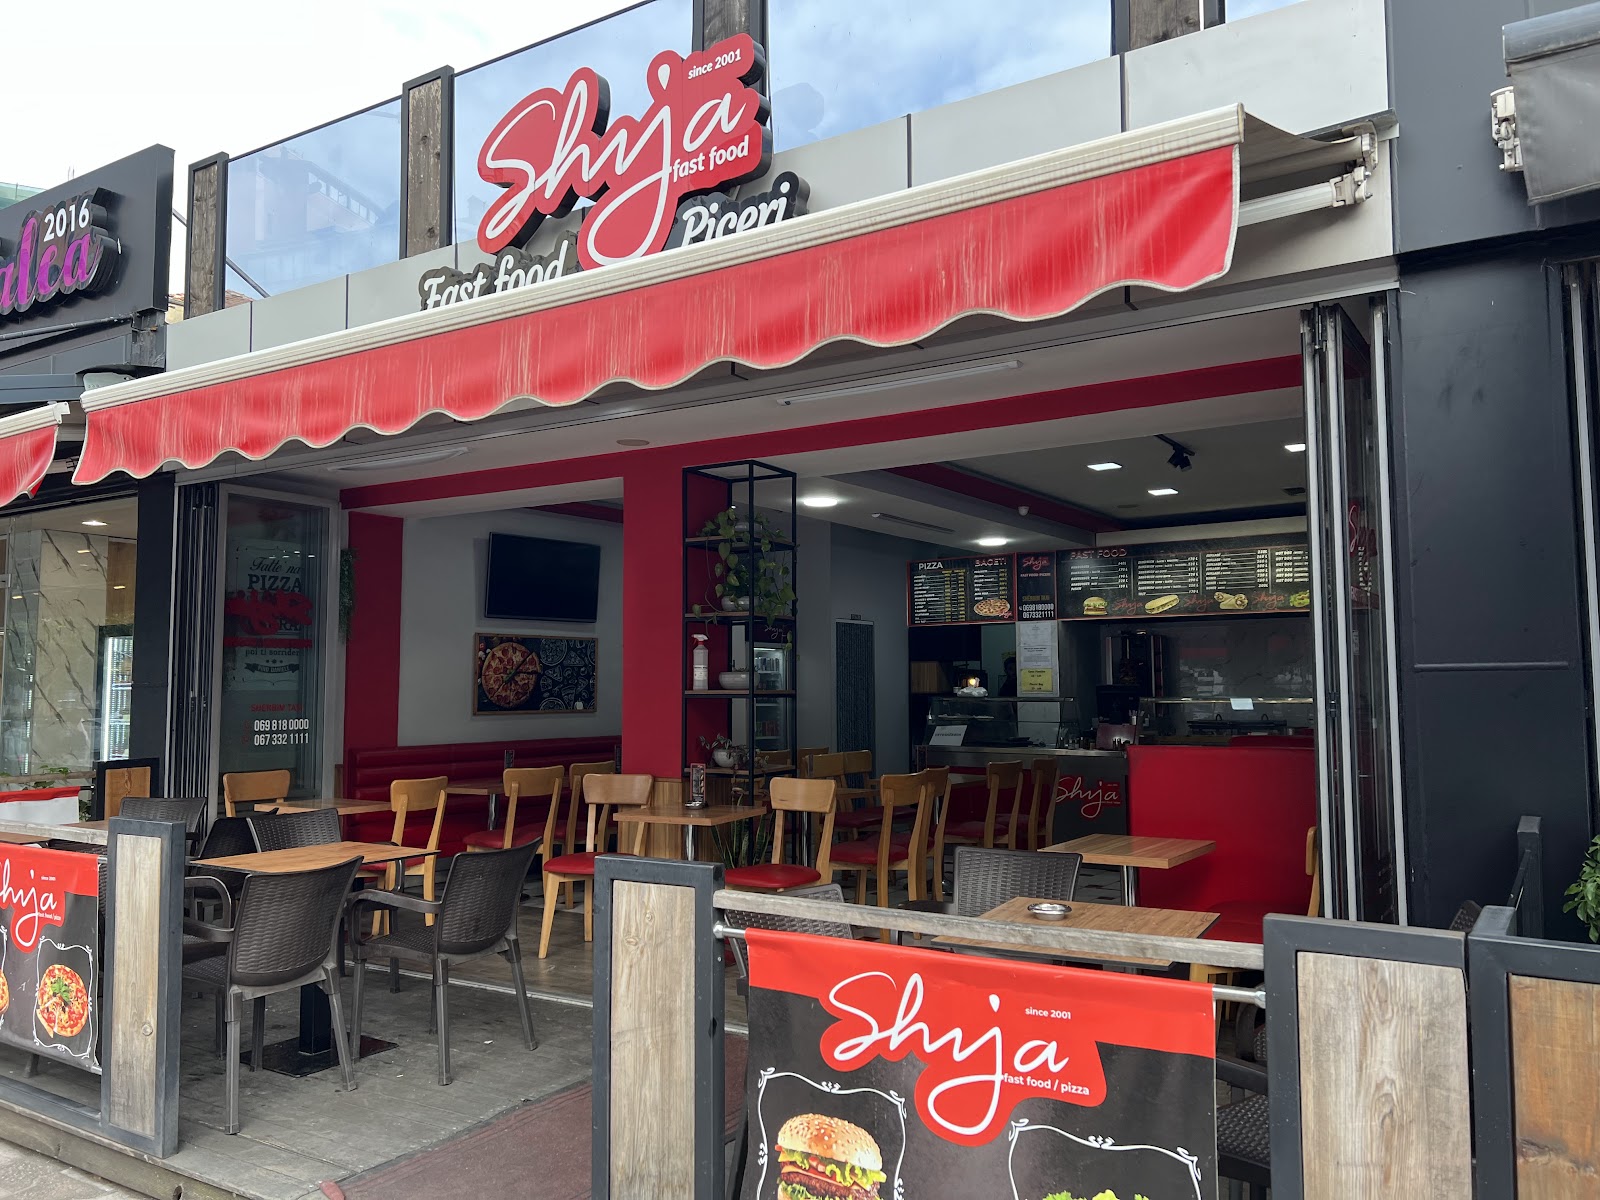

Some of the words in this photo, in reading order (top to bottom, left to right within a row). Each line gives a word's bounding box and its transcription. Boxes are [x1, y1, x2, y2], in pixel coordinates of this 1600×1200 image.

[688, 61, 713, 80] since
[715, 48, 741, 70] 2001
[672, 154, 705, 183] fast
[709, 135, 750, 171] food
[43, 198, 90, 243] 2016
[424, 271, 487, 310] Fast
[494, 239, 568, 294] food
[1070, 550, 1095, 560] FAST
[1097, 548, 1128, 558] FOOD
[919, 561, 944, 571] PIZZA
[247, 573, 303, 593] PIZZA
[254, 719, 270, 732] 069
[271, 719, 288, 731] 818
[288, 718, 310, 730] 0000
[254, 734, 270, 746] 067
[271, 733, 288, 745] 332
[289, 732, 310, 744] 1111
[1025, 1006, 1049, 1018] since
[1050, 1010, 1072, 1020] 2001
[1003, 1073, 1025, 1086] fast
[1026, 1076, 1052, 1090] food
[1060, 1082, 1090, 1096] pizza
